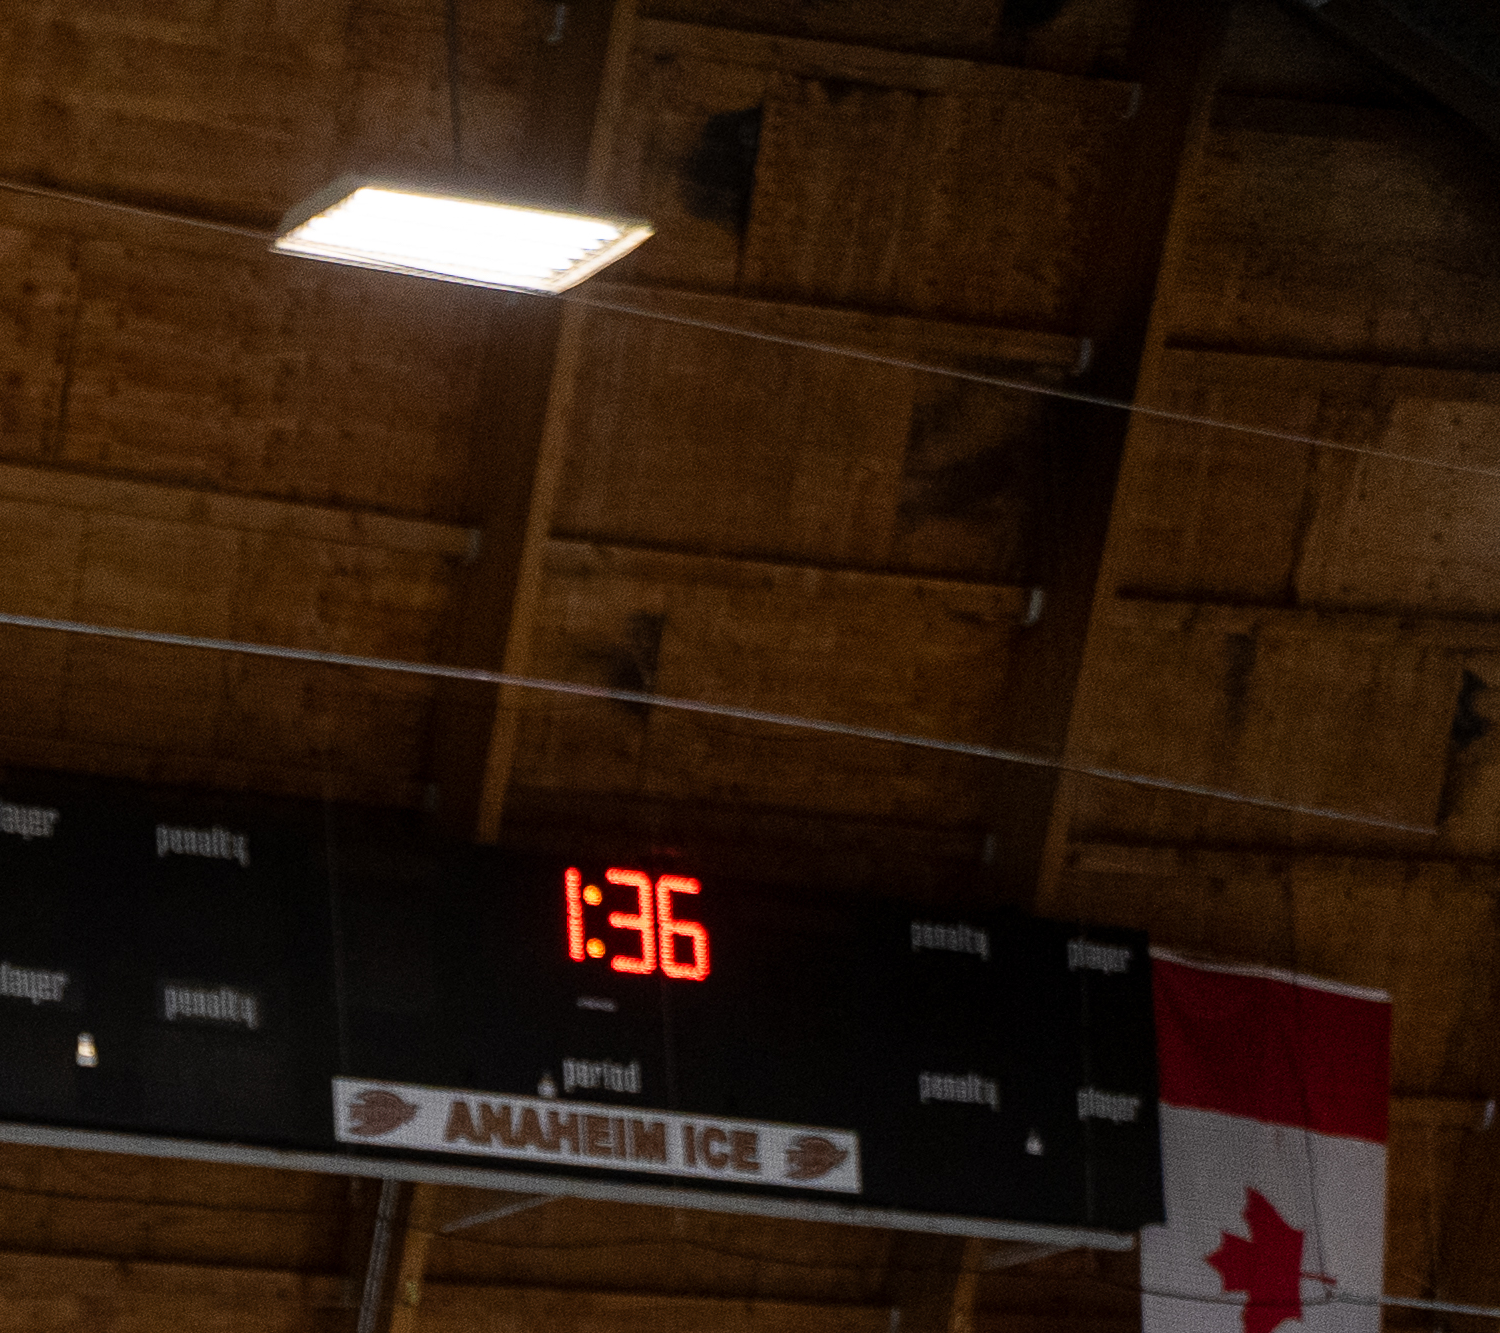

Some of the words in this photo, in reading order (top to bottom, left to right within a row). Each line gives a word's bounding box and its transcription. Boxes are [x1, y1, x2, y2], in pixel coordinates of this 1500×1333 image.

[156, 823, 250, 867] penalty
[564, 866, 711, 981] 1:36
[910, 920, 990, 962] penalty
[1067, 934, 1132, 975] player
[164, 983, 258, 1029] penalty
[562, 1056, 642, 1094] period
[918, 1071, 999, 1113] penalty
[1077, 1085, 1141, 1125] player
[442, 1098, 668, 1166] ANAHEIM
[683, 1125, 761, 1172] ICE
